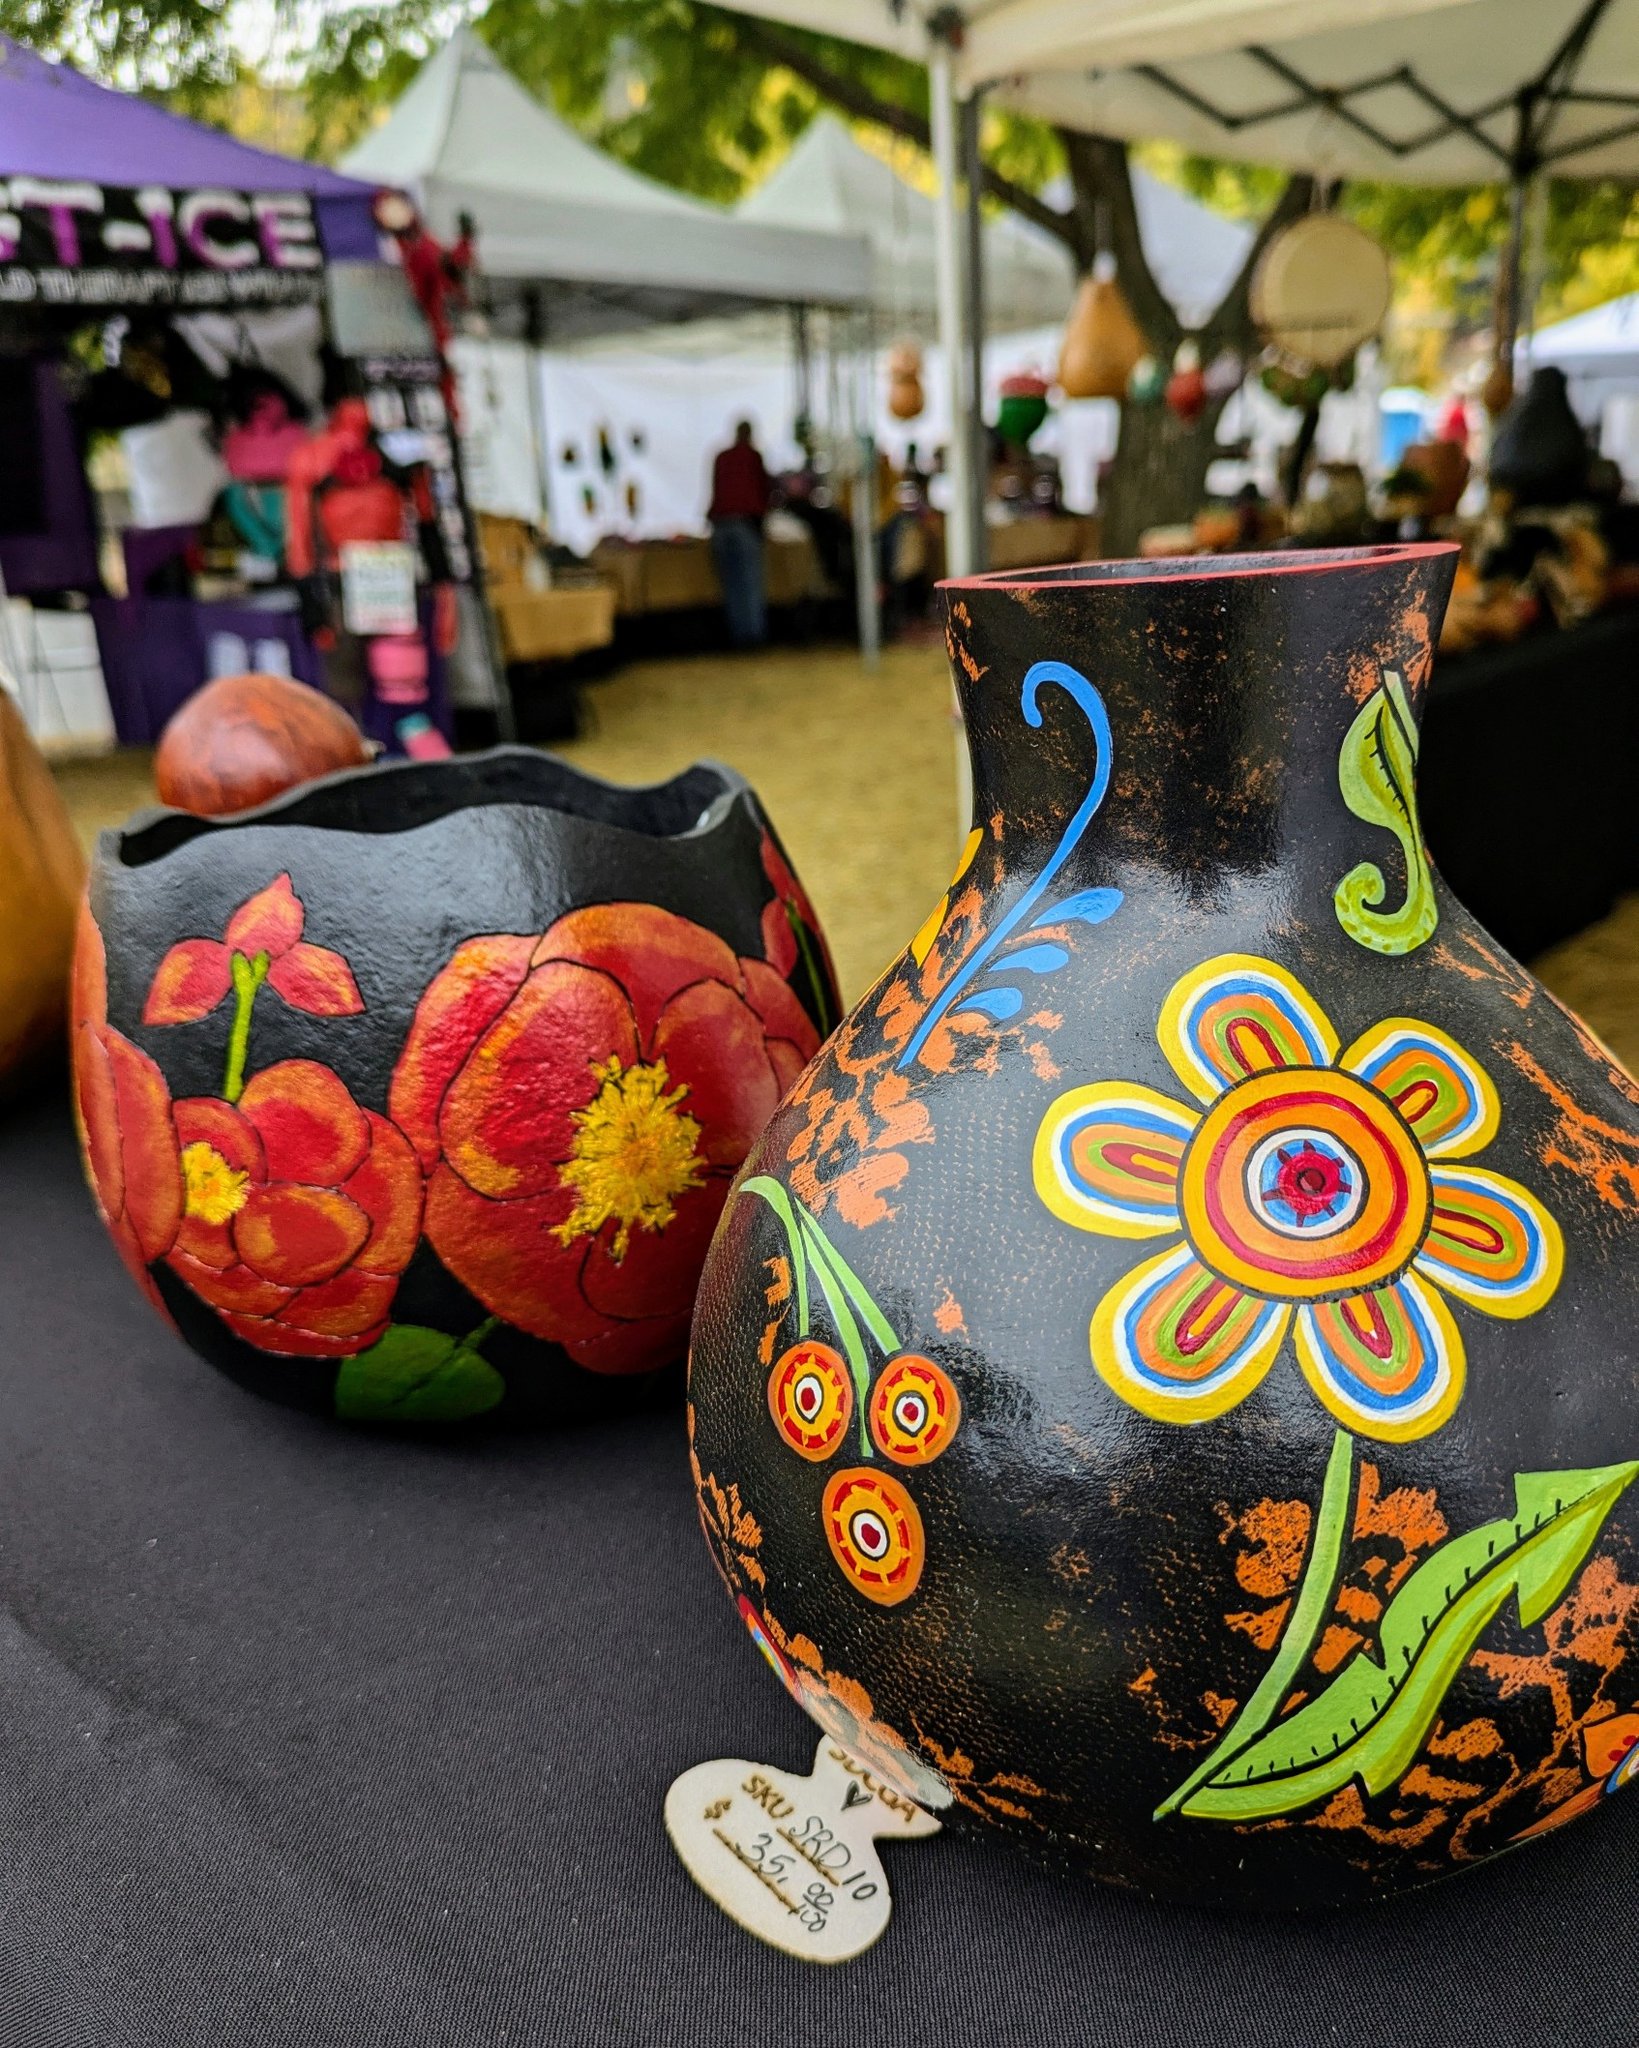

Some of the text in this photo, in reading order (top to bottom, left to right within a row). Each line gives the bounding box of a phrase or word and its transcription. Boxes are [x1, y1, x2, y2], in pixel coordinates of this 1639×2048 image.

[704, 1799, 732, 1820] $
[742, 1775, 794, 1819] SKU
[842, 1870, 878, 1900] 10
